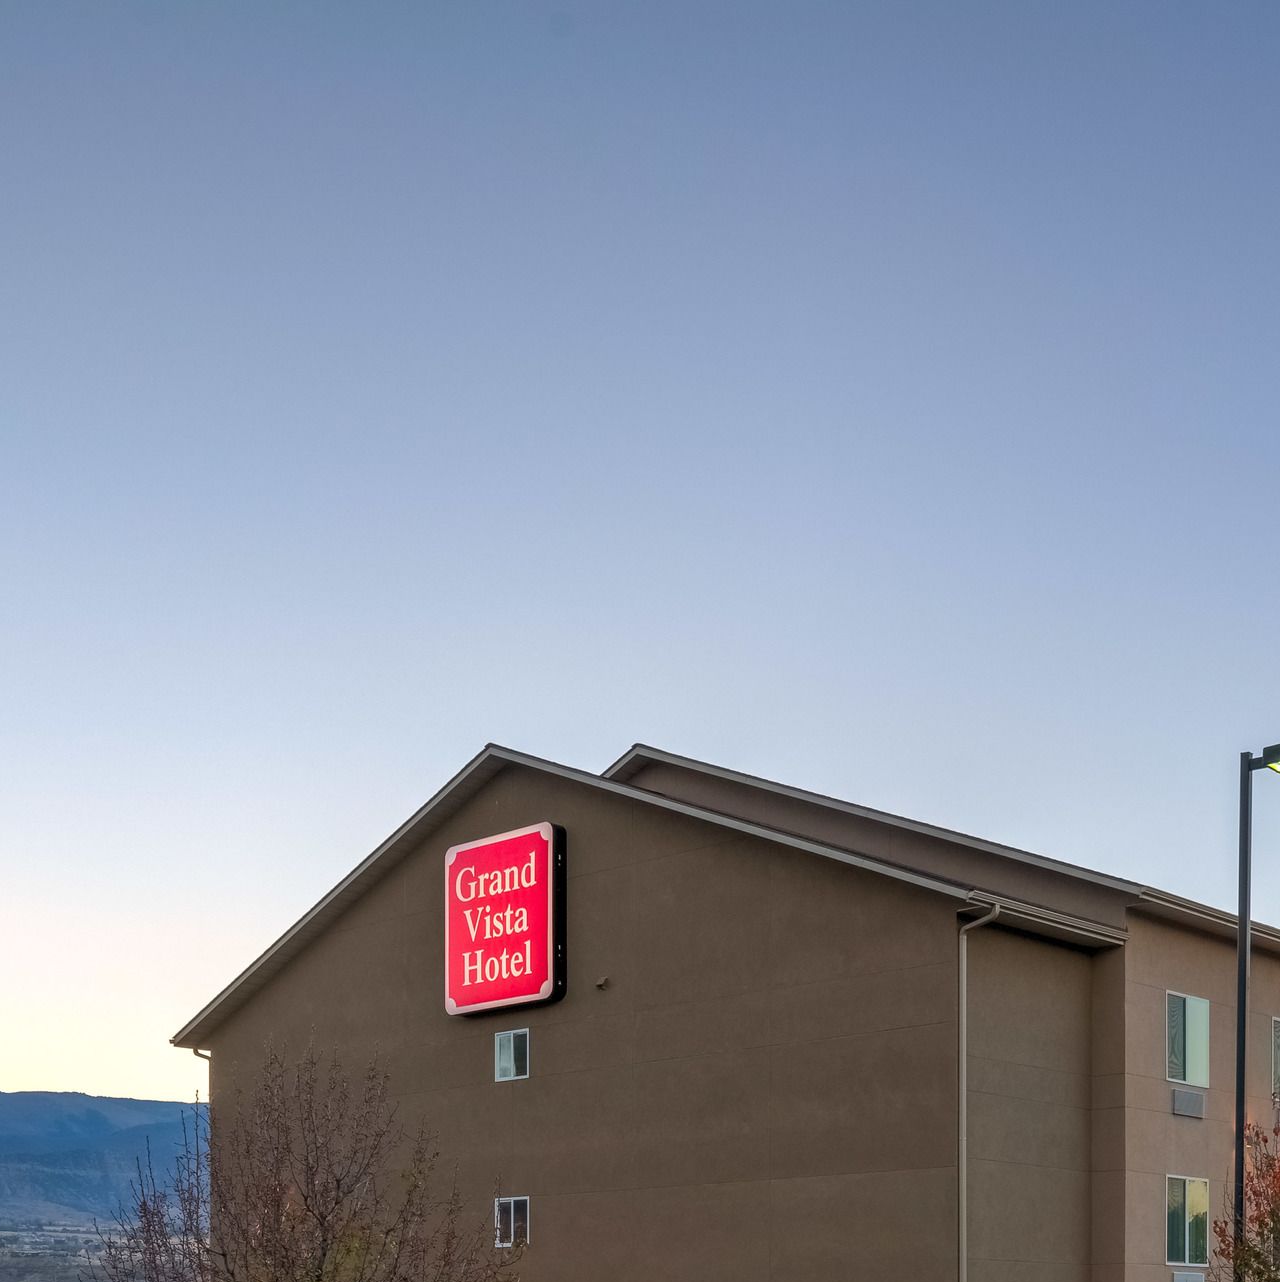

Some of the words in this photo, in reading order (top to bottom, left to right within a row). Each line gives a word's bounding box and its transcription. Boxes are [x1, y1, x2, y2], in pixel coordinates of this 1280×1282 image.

[455, 851, 537, 902] Grand
[463, 903, 529, 942] Vista
[461, 939, 532, 987] Hotel
